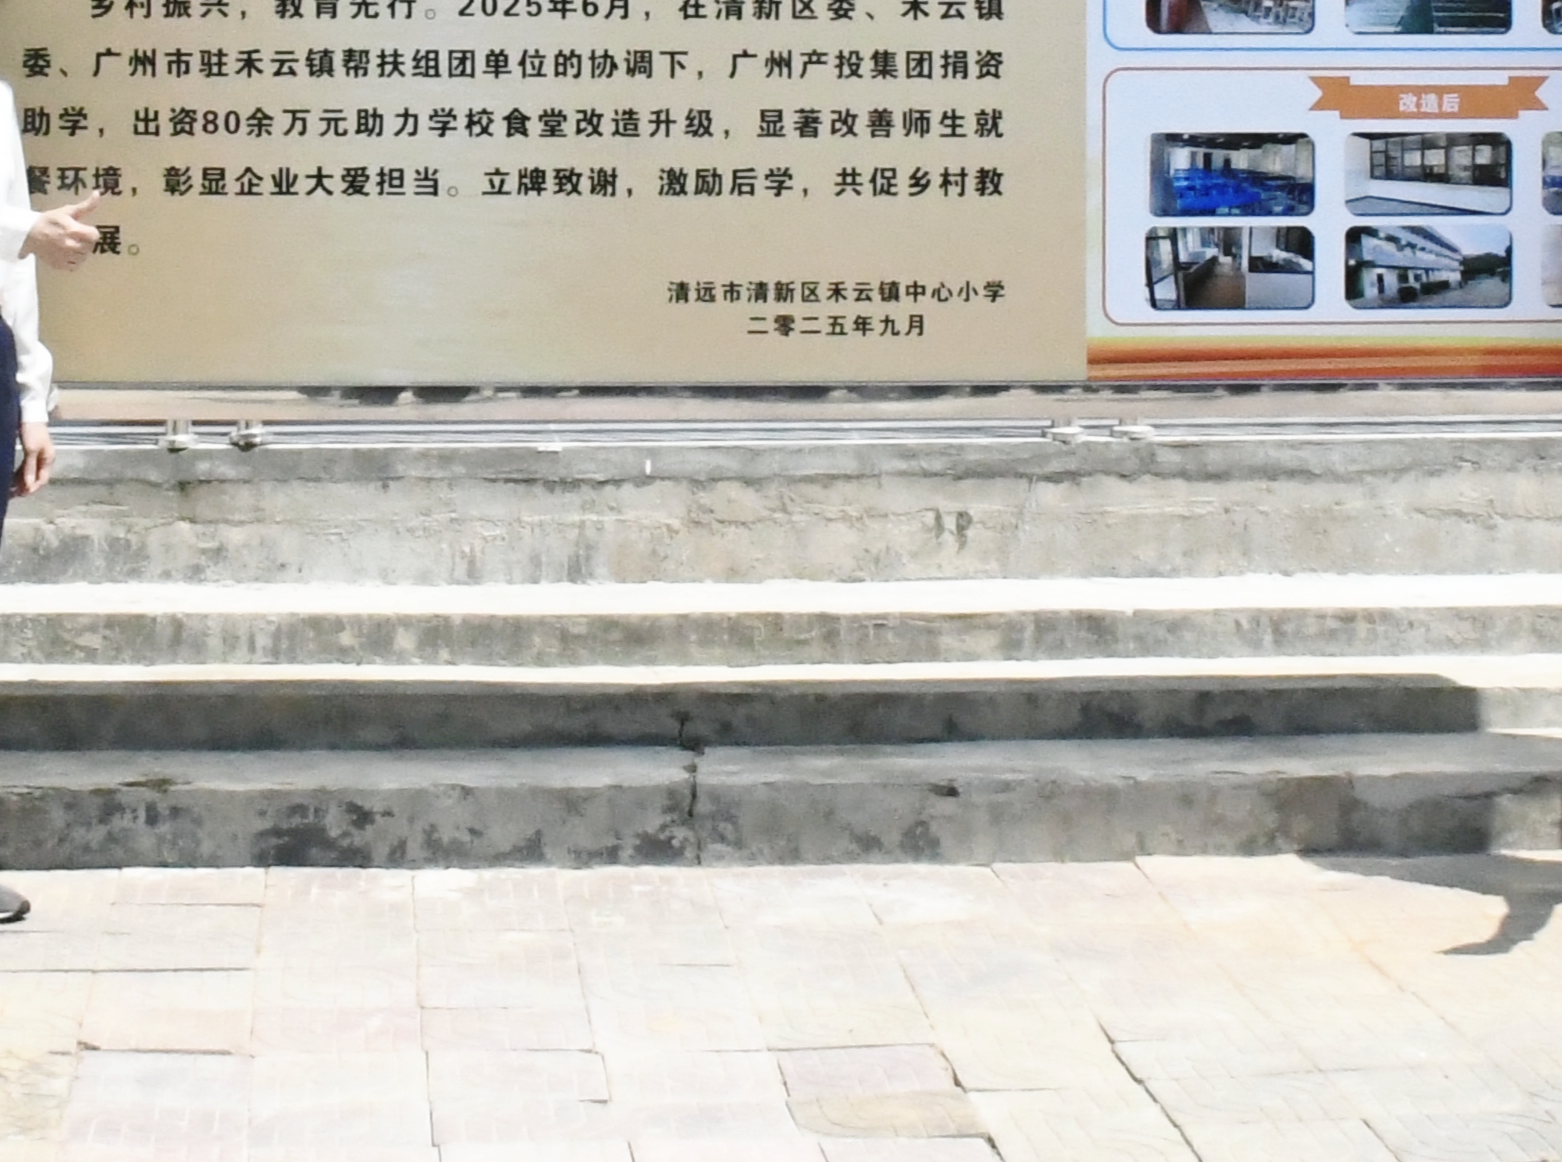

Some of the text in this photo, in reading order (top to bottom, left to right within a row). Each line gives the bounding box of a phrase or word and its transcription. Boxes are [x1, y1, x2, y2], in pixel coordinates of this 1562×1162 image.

[21, 46, 1005, 80] 委、广州市驻禾云镇帮扶组团单位的协调下，广州产投集团捐资
[1398, 92, 1461, 113] 改造后
[21, 105, 1005, 139] 助学，出资80余万元助力学校食堂改造升级，显著改善师生就
[667, 279, 1006, 304] 清远市清新区禾云镇中心小学
[747, 313, 926, 337] 二零二五年九月
